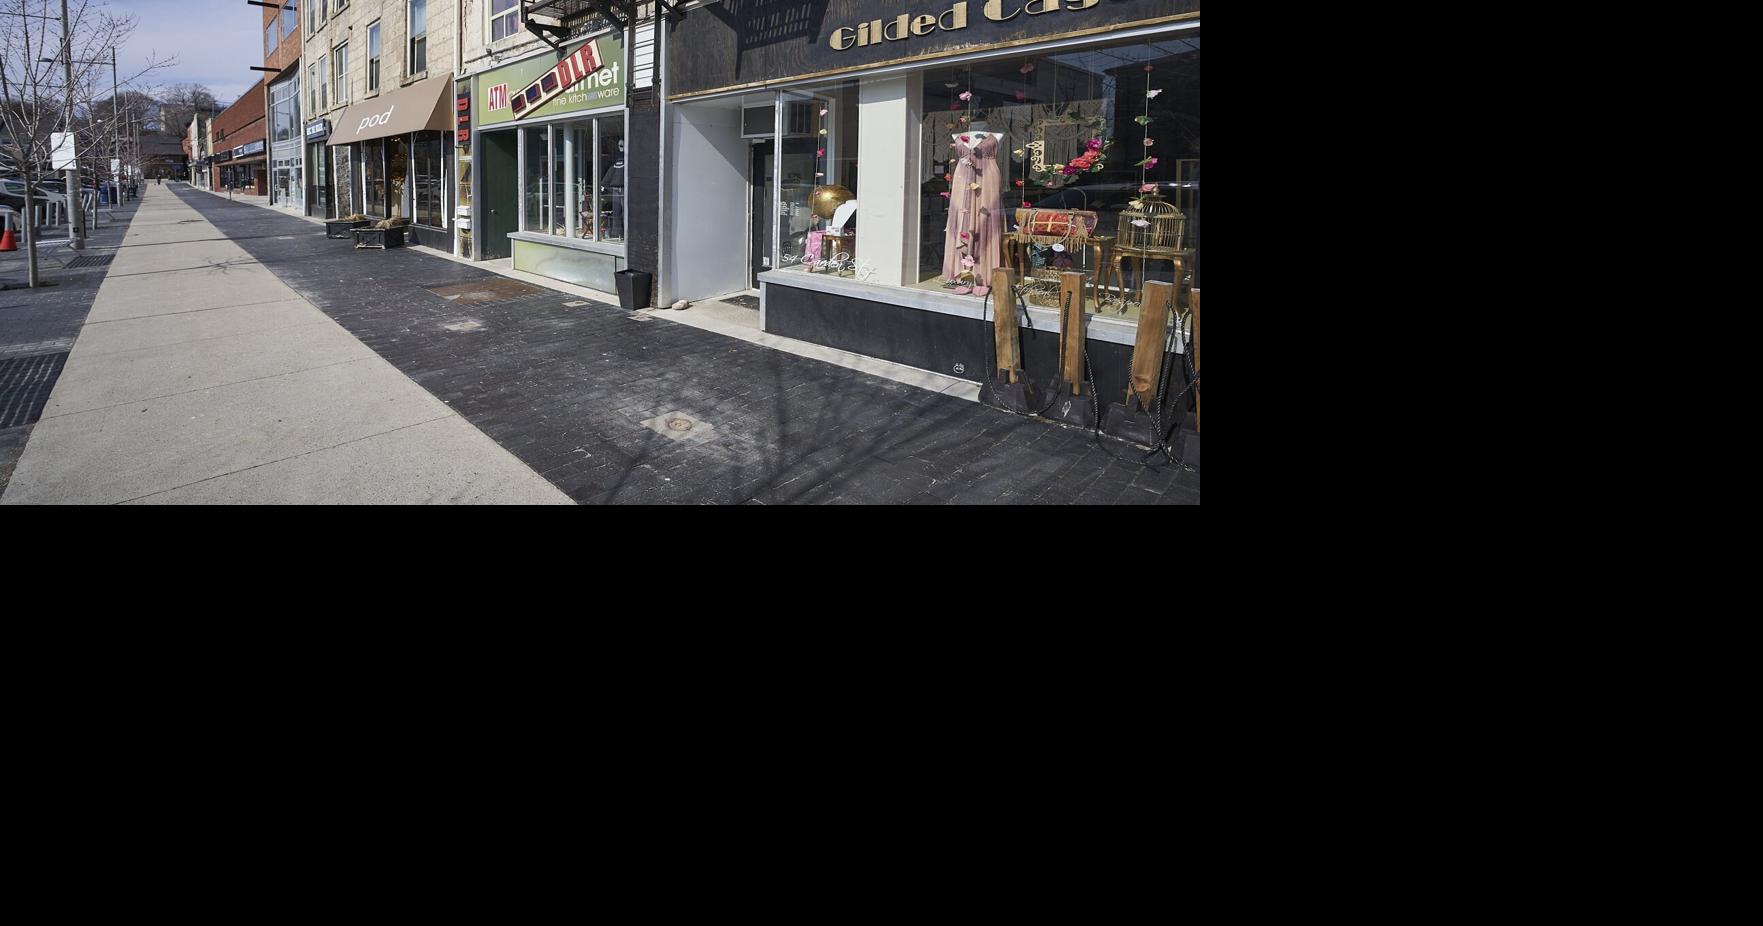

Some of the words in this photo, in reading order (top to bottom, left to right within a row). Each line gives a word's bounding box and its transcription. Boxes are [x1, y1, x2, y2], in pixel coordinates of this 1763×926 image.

[829, 1, 968, 51] Gilded
[557, 44, 597, 89] DLR
[488, 84, 507, 110] ATM
[356, 105, 394, 135] pod
[782, 253, 798, 264] 54
